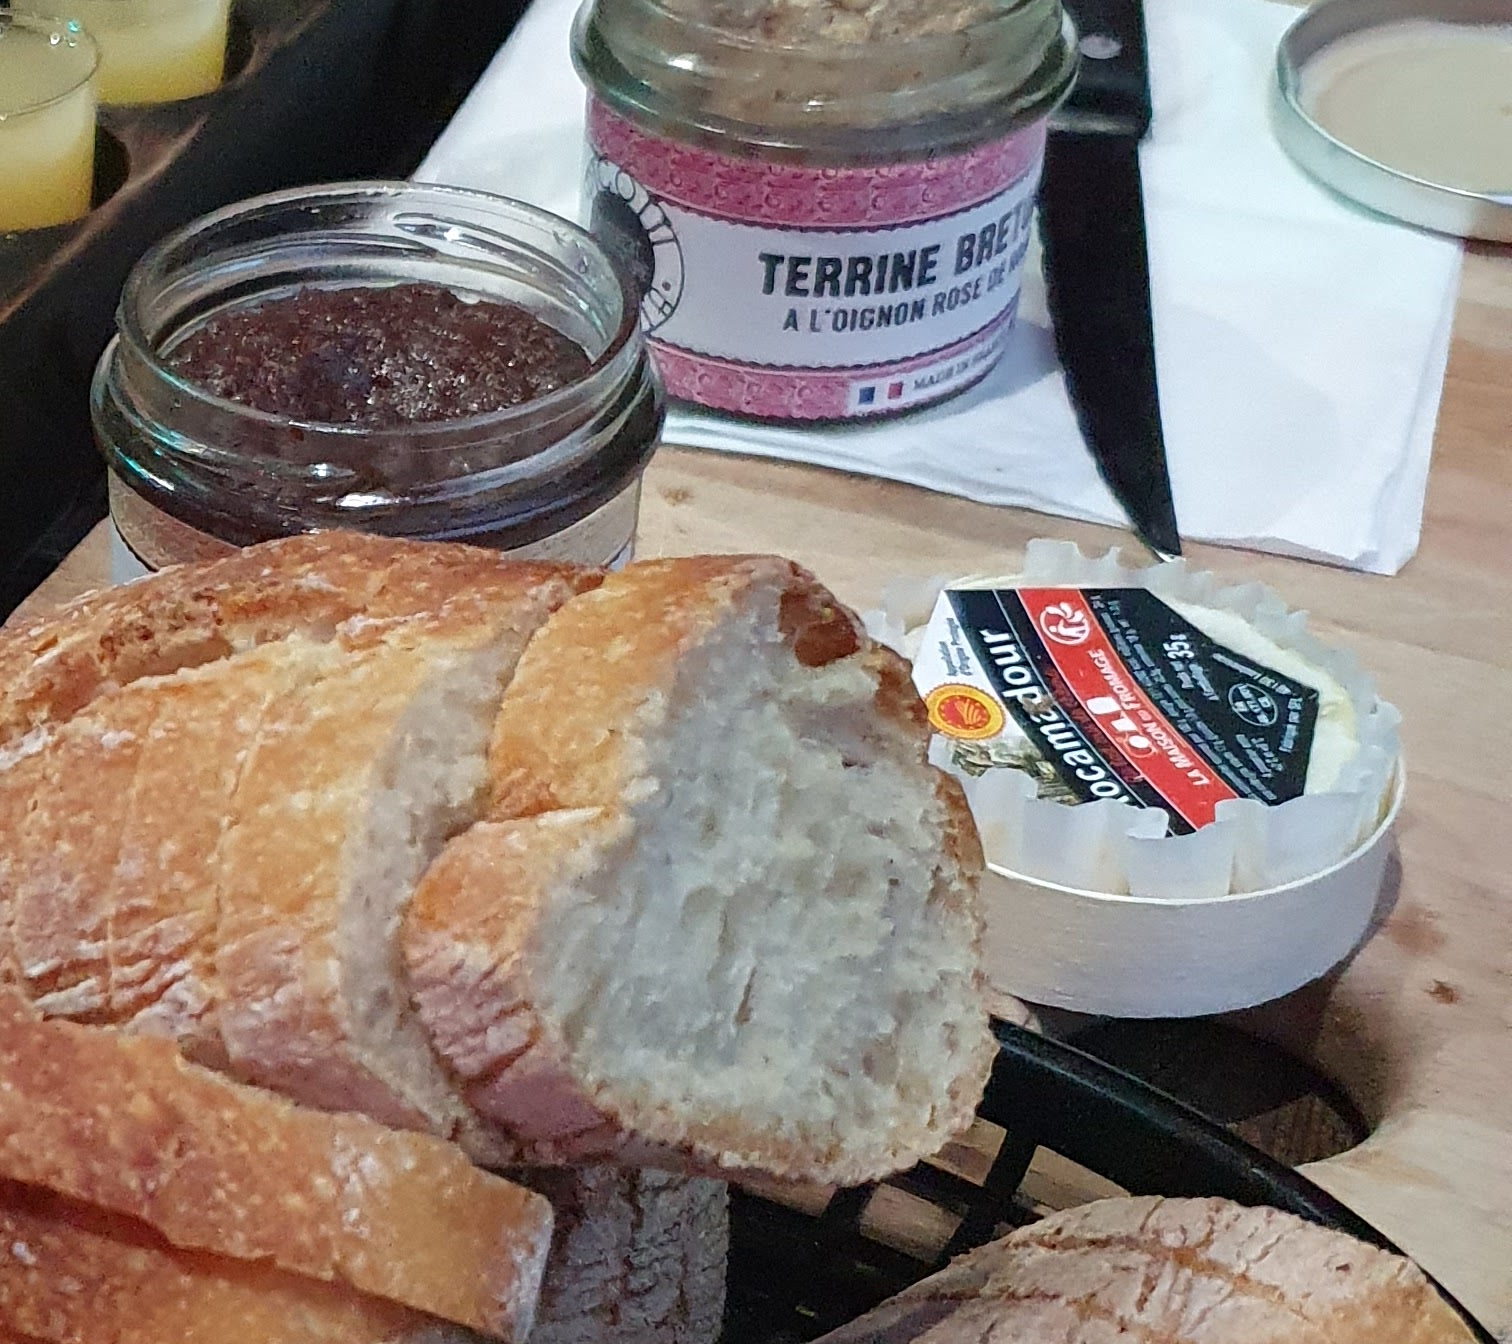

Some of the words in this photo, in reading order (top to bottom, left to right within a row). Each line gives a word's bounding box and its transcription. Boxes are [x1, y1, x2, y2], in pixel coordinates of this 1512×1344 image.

[758, 244, 941, 297] TERRINE
[782, 309, 799, 332] A
[810, 299, 925, 333] L'OIGNON
[931, 277, 983, 317] ROSE
[1088, 648, 1135, 711] FROMAGE
[979, 628, 1136, 807] ocamadour
[1143, 723, 1191, 775] MAISON
